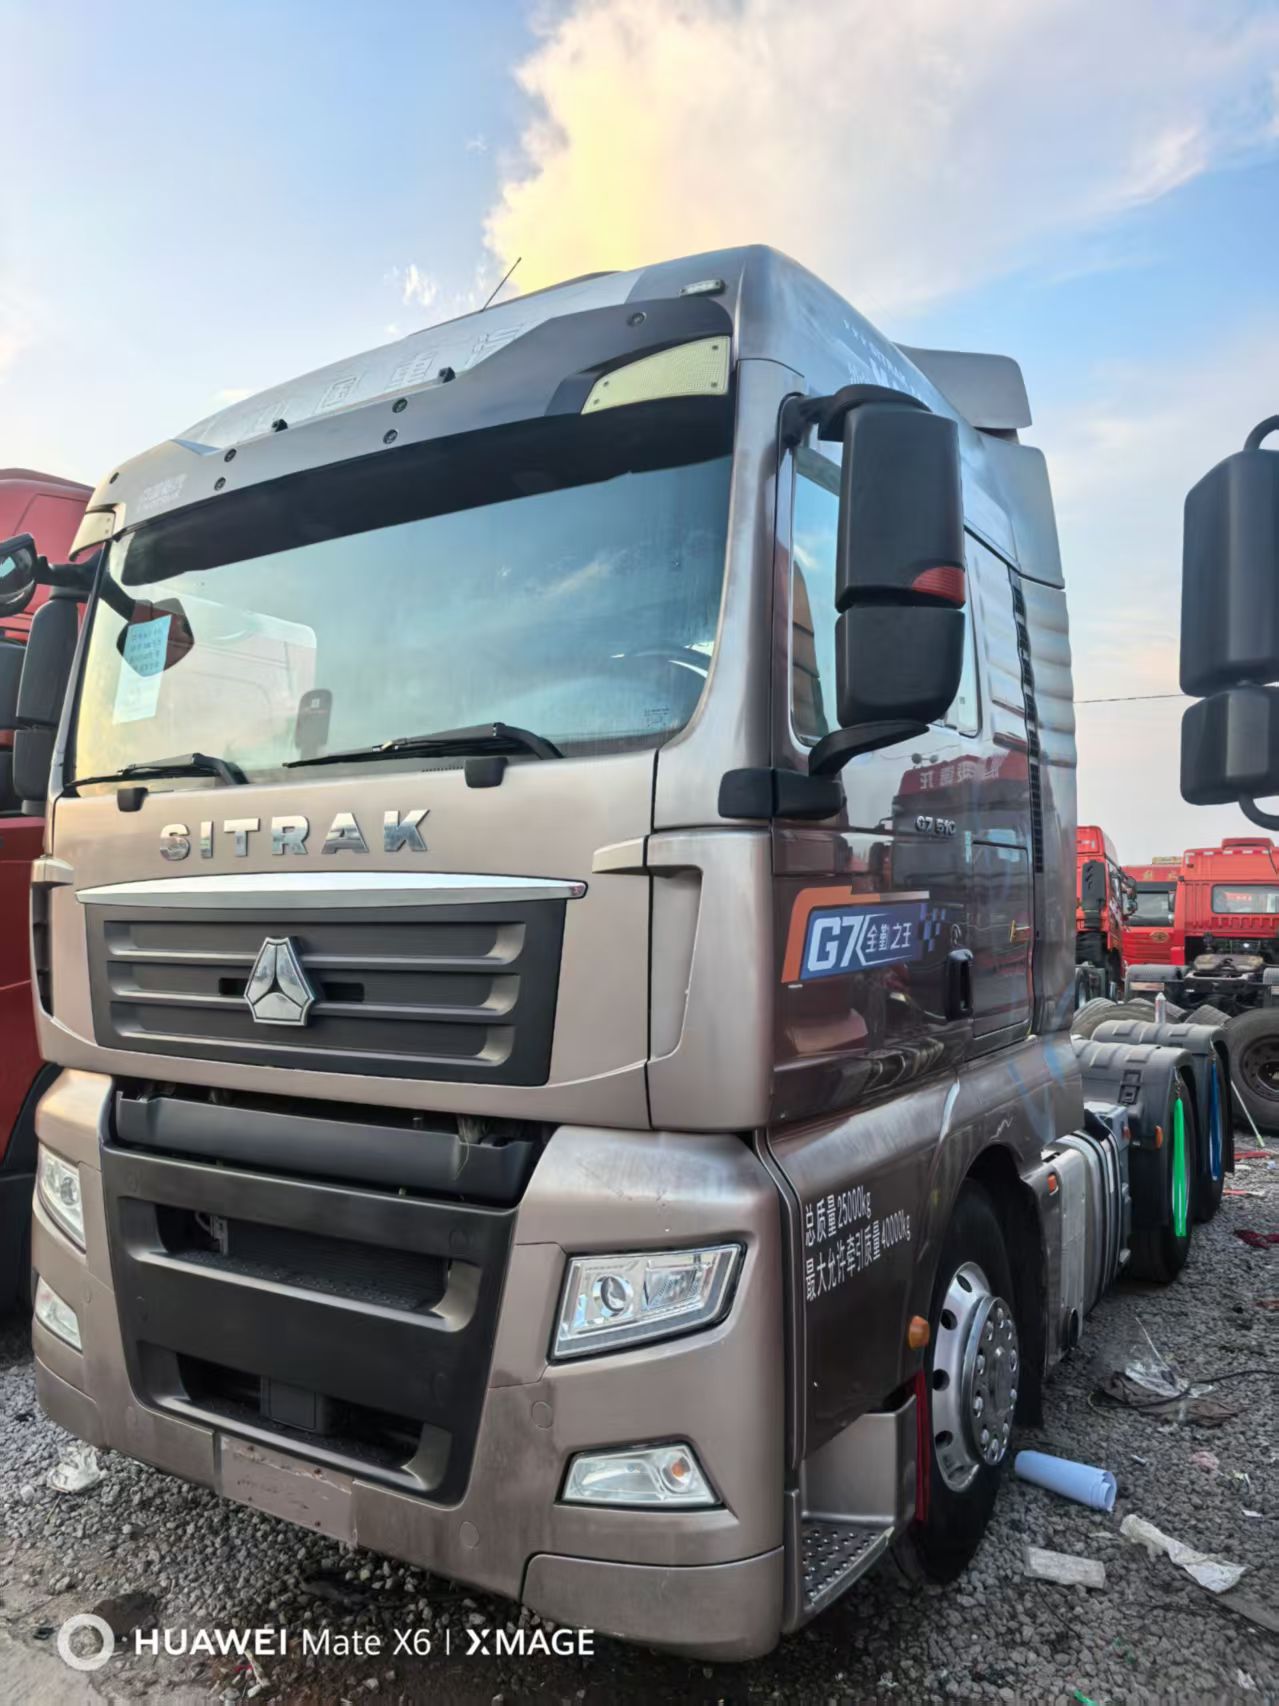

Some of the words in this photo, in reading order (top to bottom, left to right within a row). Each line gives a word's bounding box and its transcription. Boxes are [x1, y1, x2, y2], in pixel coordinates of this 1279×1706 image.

[159, 808, 431, 861] SITRAK
[915, 815, 934, 832] G7
[807, 915, 864, 972] G7
